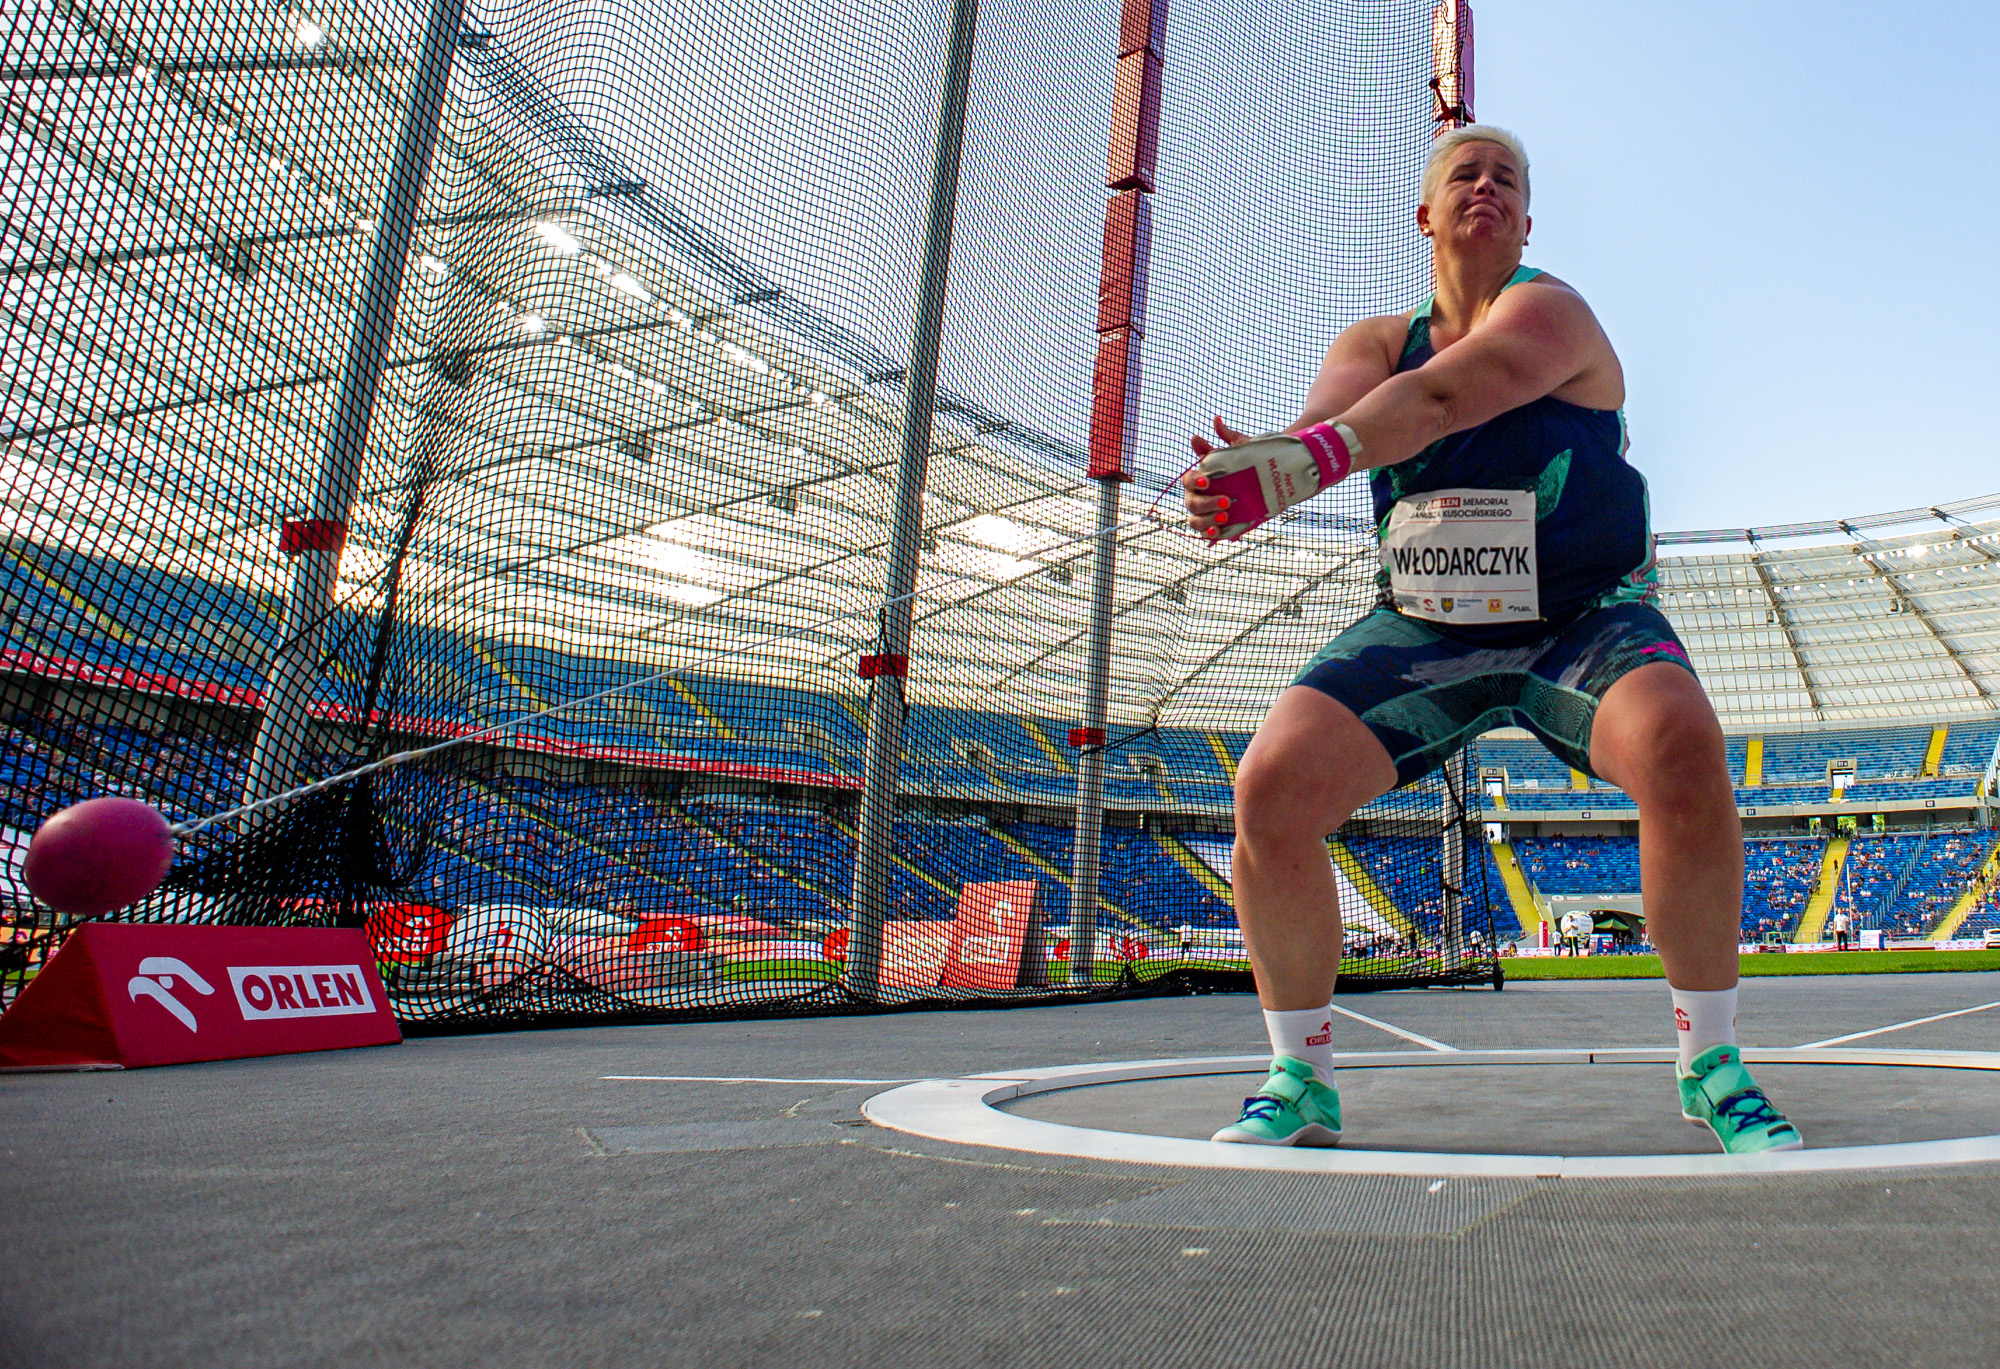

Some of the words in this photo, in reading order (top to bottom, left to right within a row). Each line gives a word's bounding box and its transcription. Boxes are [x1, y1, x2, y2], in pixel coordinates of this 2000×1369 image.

[1443, 508, 1512, 518] KUSOCIŃSKIEGO
[1393, 546, 1530, 576] WŁODARCZYK
[242, 972, 365, 1011] ORLEN
